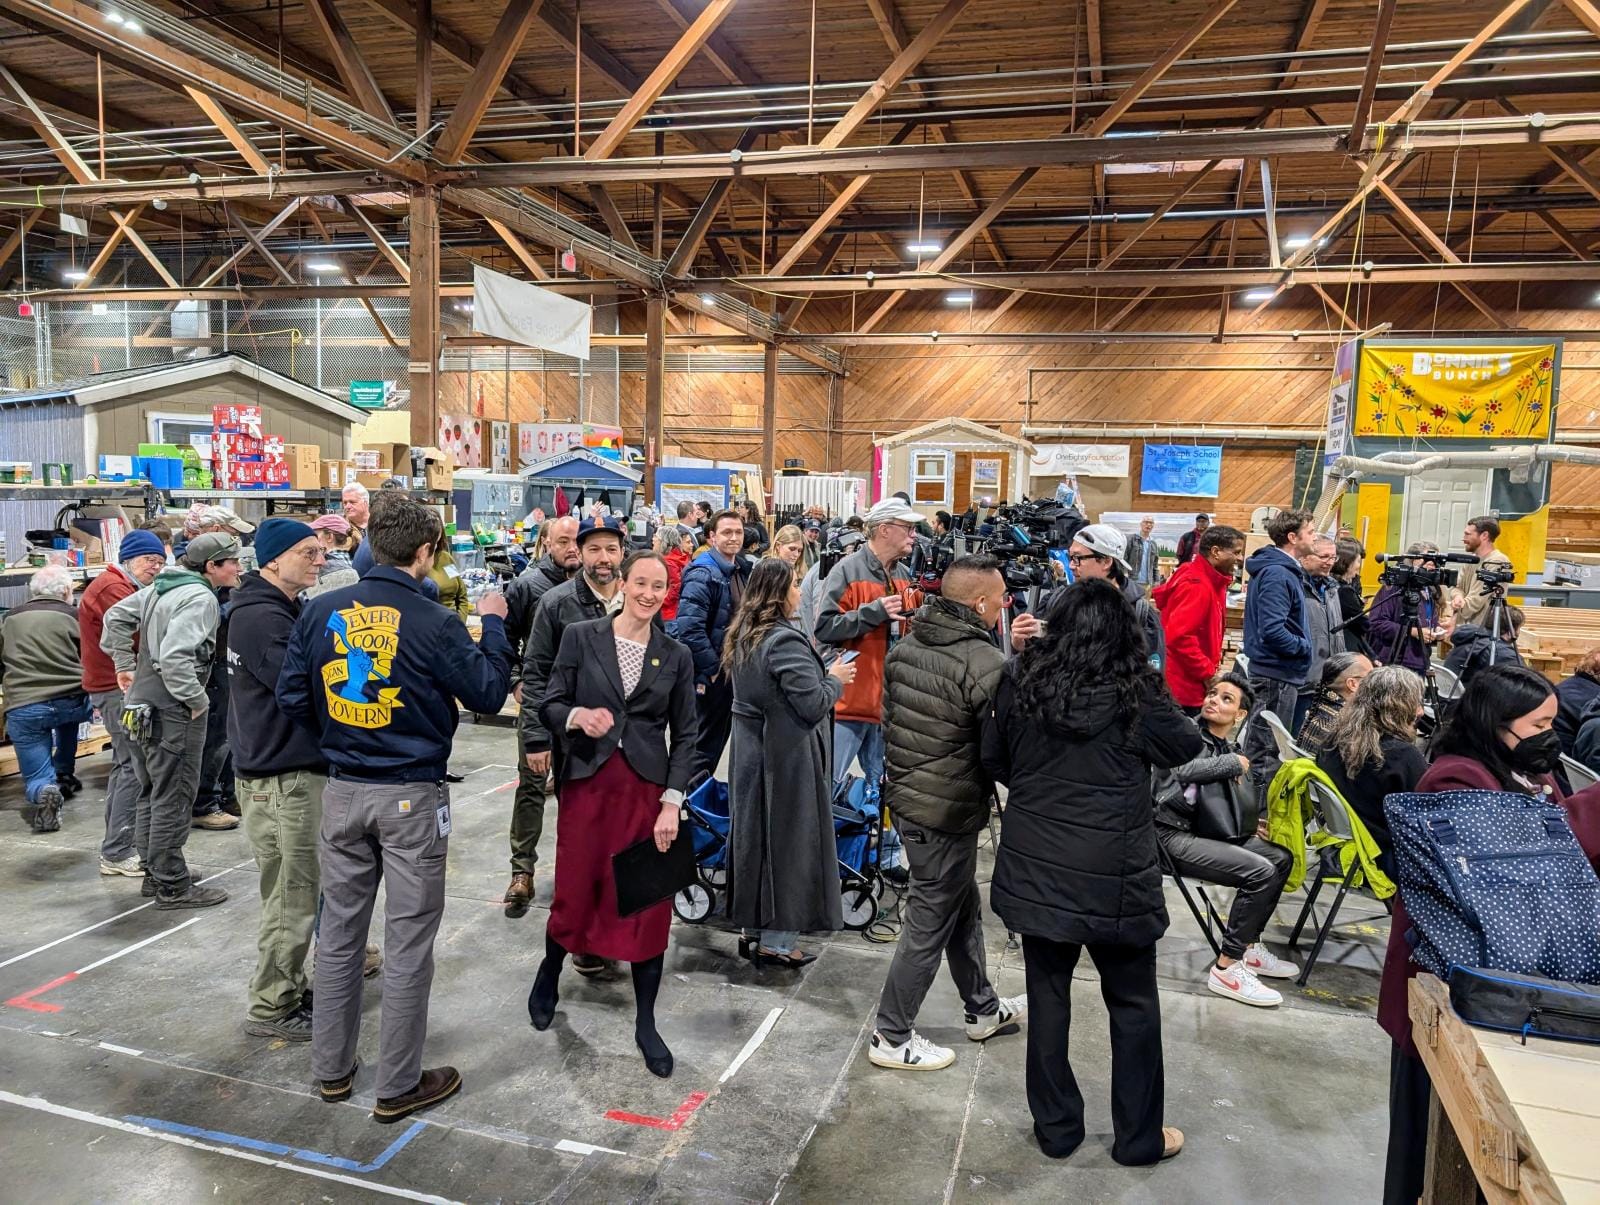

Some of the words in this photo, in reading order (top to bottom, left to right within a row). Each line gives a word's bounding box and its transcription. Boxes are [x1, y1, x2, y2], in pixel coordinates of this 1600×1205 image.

[1433, 370, 1492, 380] BUNCH
[521, 430, 581, 453] HOPE
[551, 453, 576, 467] THANK
[585, 452, 606, 466] YOU
[1147, 448, 1160, 456] St.
[1162, 448, 1191, 460] Joseph
[1193, 449, 1220, 458] School
[349, 609, 398, 628] EVERY
[352, 633, 395, 652] COOK
[328, 665, 344, 678] CAN
[329, 696, 388, 724] GOVERN
